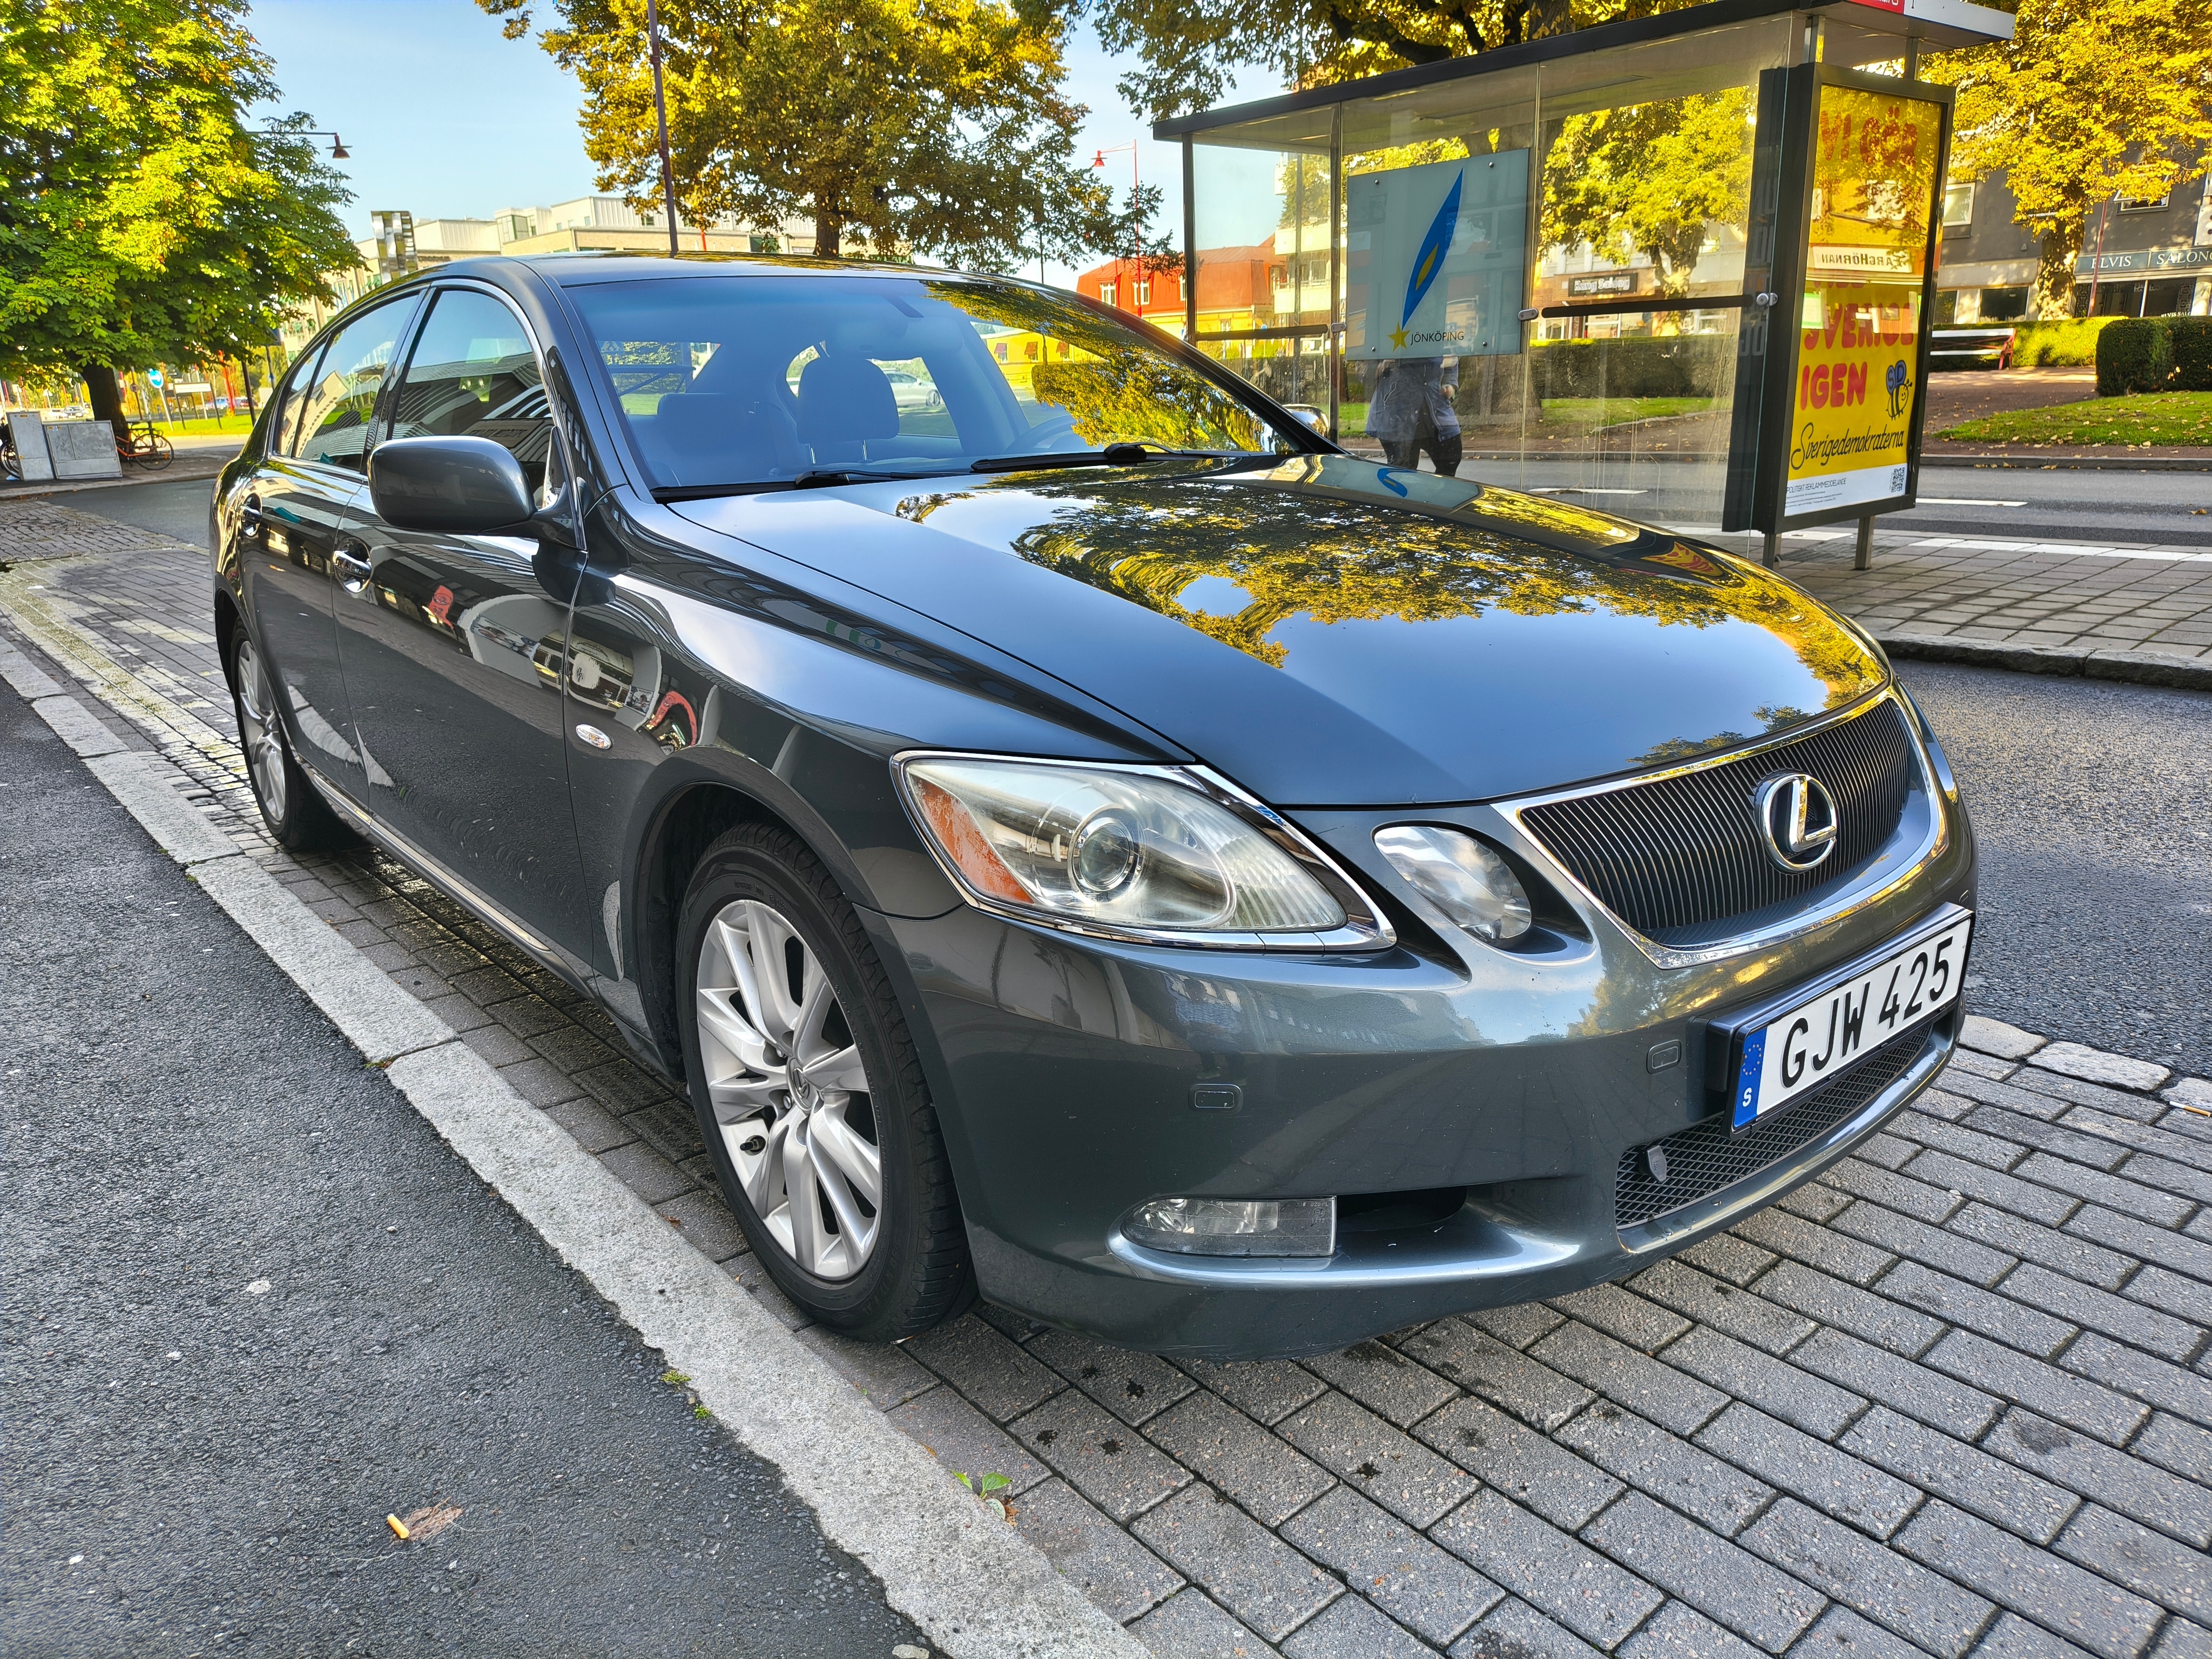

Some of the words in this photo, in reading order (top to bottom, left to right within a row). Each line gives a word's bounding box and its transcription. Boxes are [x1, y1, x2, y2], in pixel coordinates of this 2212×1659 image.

[2156, 251, 2212, 265] SALON
[1411, 331, 1464, 346] JÖNKÖPING
[1800, 361, 1867, 411] IGEN
[1887, 364, 1905, 390] SD
[1790, 422, 1904, 470] Sverigedemokraterna
[1781, 981, 1870, 1088] GJW
[1878, 935, 1953, 1030] 425
[1742, 1087, 1751, 1108] S
